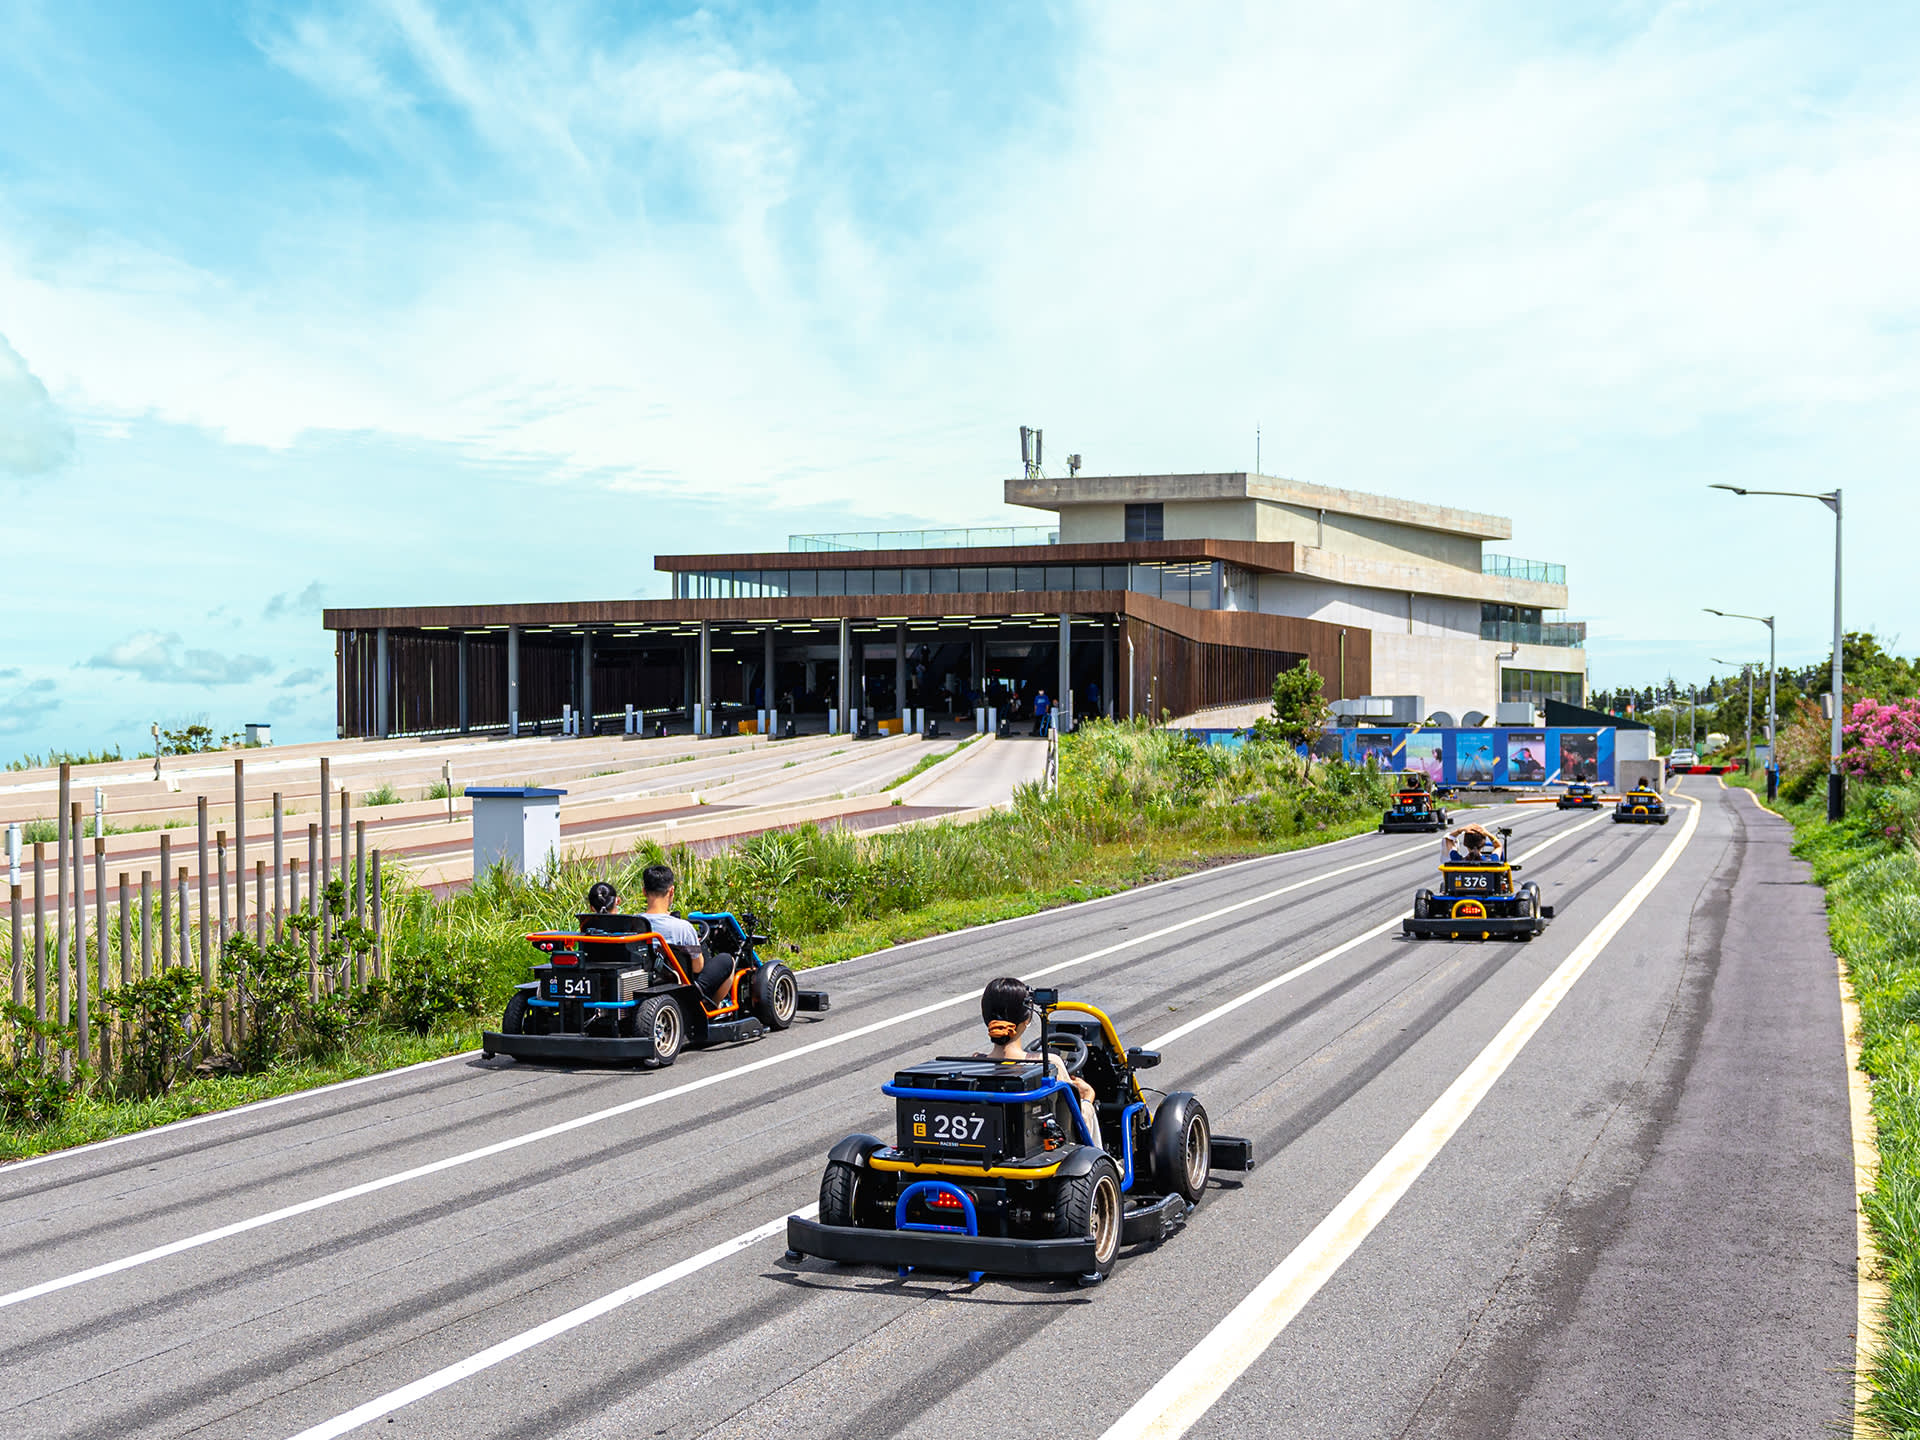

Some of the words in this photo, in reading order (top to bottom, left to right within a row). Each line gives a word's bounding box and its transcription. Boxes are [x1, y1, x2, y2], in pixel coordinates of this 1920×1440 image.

[1464, 877, 1487, 887] 376
[564, 979, 591, 994] 541
[913, 1113, 926, 1121] GR
[934, 1115, 985, 1140] 287
